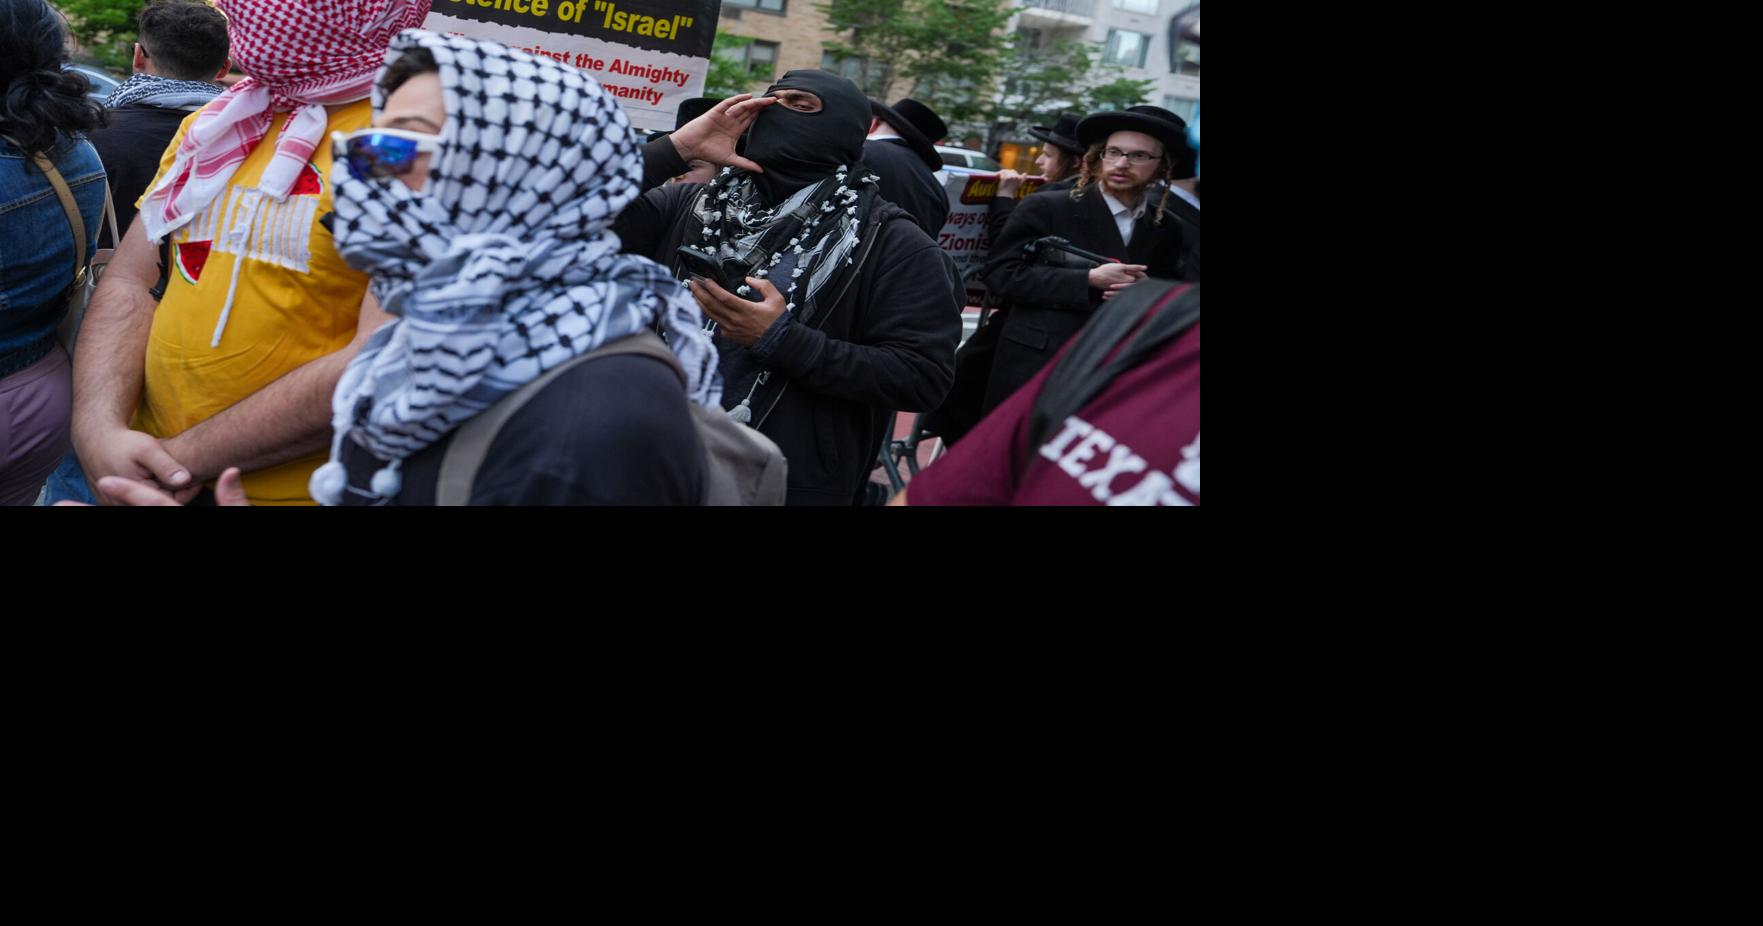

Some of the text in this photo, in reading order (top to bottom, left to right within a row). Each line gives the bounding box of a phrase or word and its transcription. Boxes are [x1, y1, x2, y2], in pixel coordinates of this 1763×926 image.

[557, 0, 586, 23] of
[594, 1, 693, 41] "Israel"
[575, 53, 604, 71] the
[608, 58, 690, 87] Almighty
[602, 83, 664, 106] manity
[939, 233, 993, 251] Zionis
